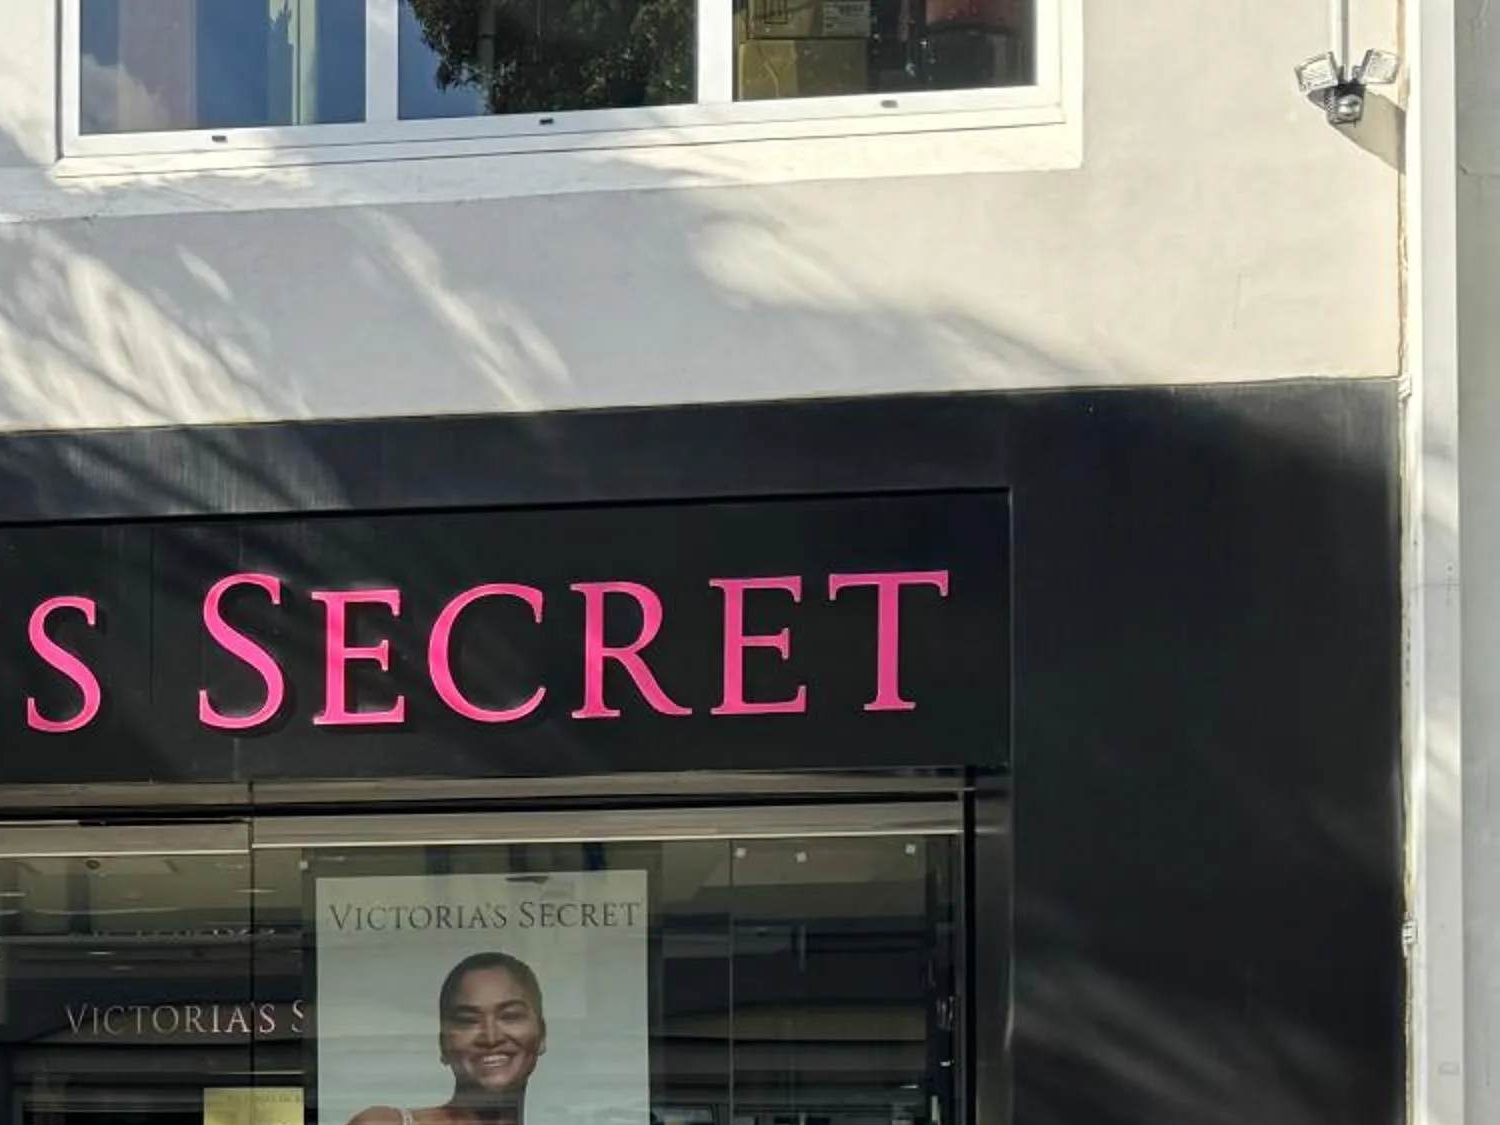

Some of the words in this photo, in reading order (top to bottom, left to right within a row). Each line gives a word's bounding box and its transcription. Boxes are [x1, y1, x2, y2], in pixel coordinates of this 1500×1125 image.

[199, 572, 950, 730] SECRET
[328, 903, 508, 931] VICTORIA'S
[518, 901, 640, 930] SECRET
[66, 1002, 276, 1035] VICTORIA'S
